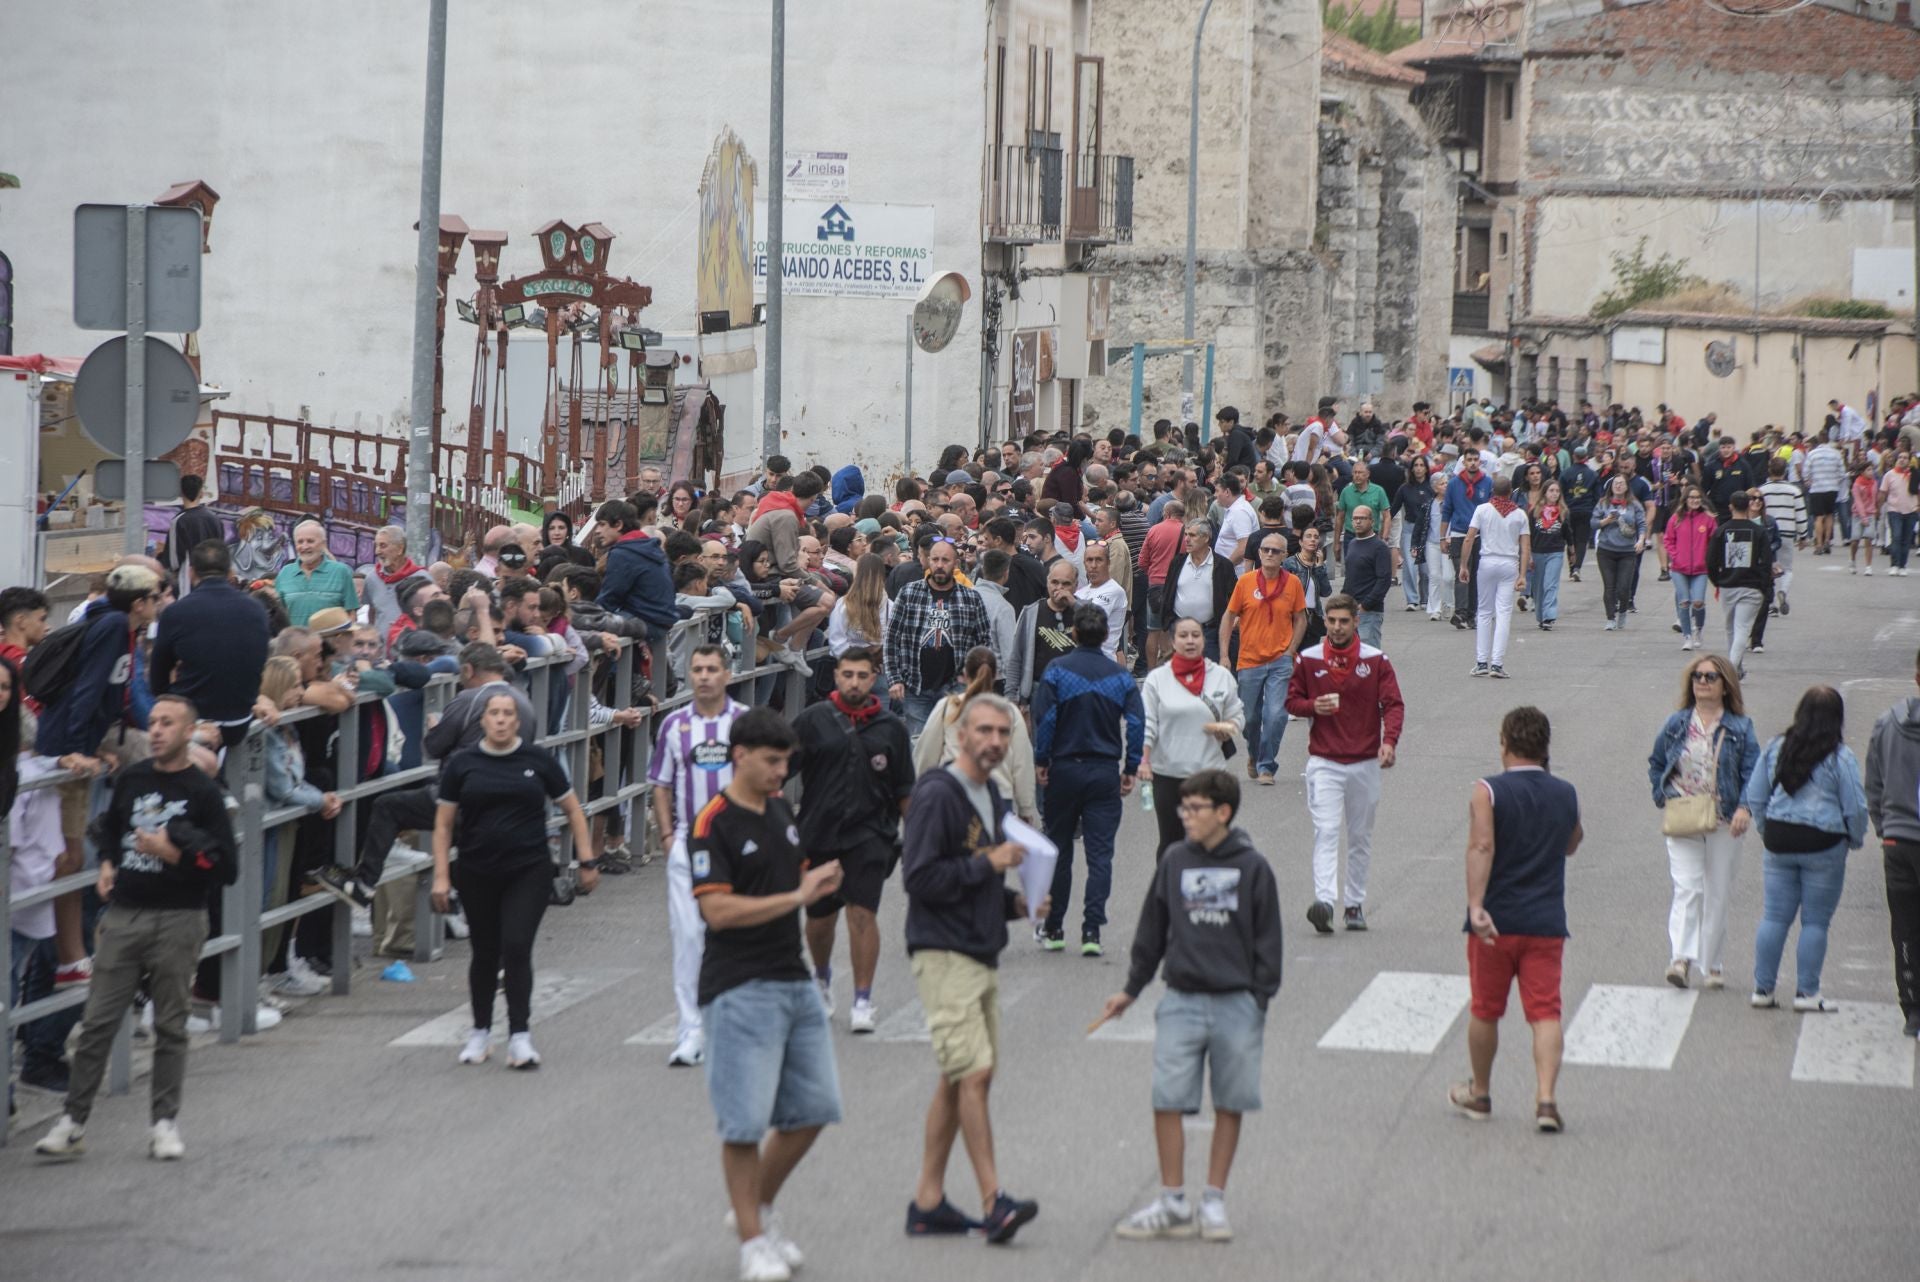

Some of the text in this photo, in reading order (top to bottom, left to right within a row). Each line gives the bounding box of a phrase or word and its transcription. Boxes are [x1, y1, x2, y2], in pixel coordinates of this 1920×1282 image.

[808, 162, 845, 176] inelsa
[753, 241, 927, 259] OTRUCCIONES Y REFORMAS
[753, 255, 925, 286] HENANDO ACEBES, S.L.
